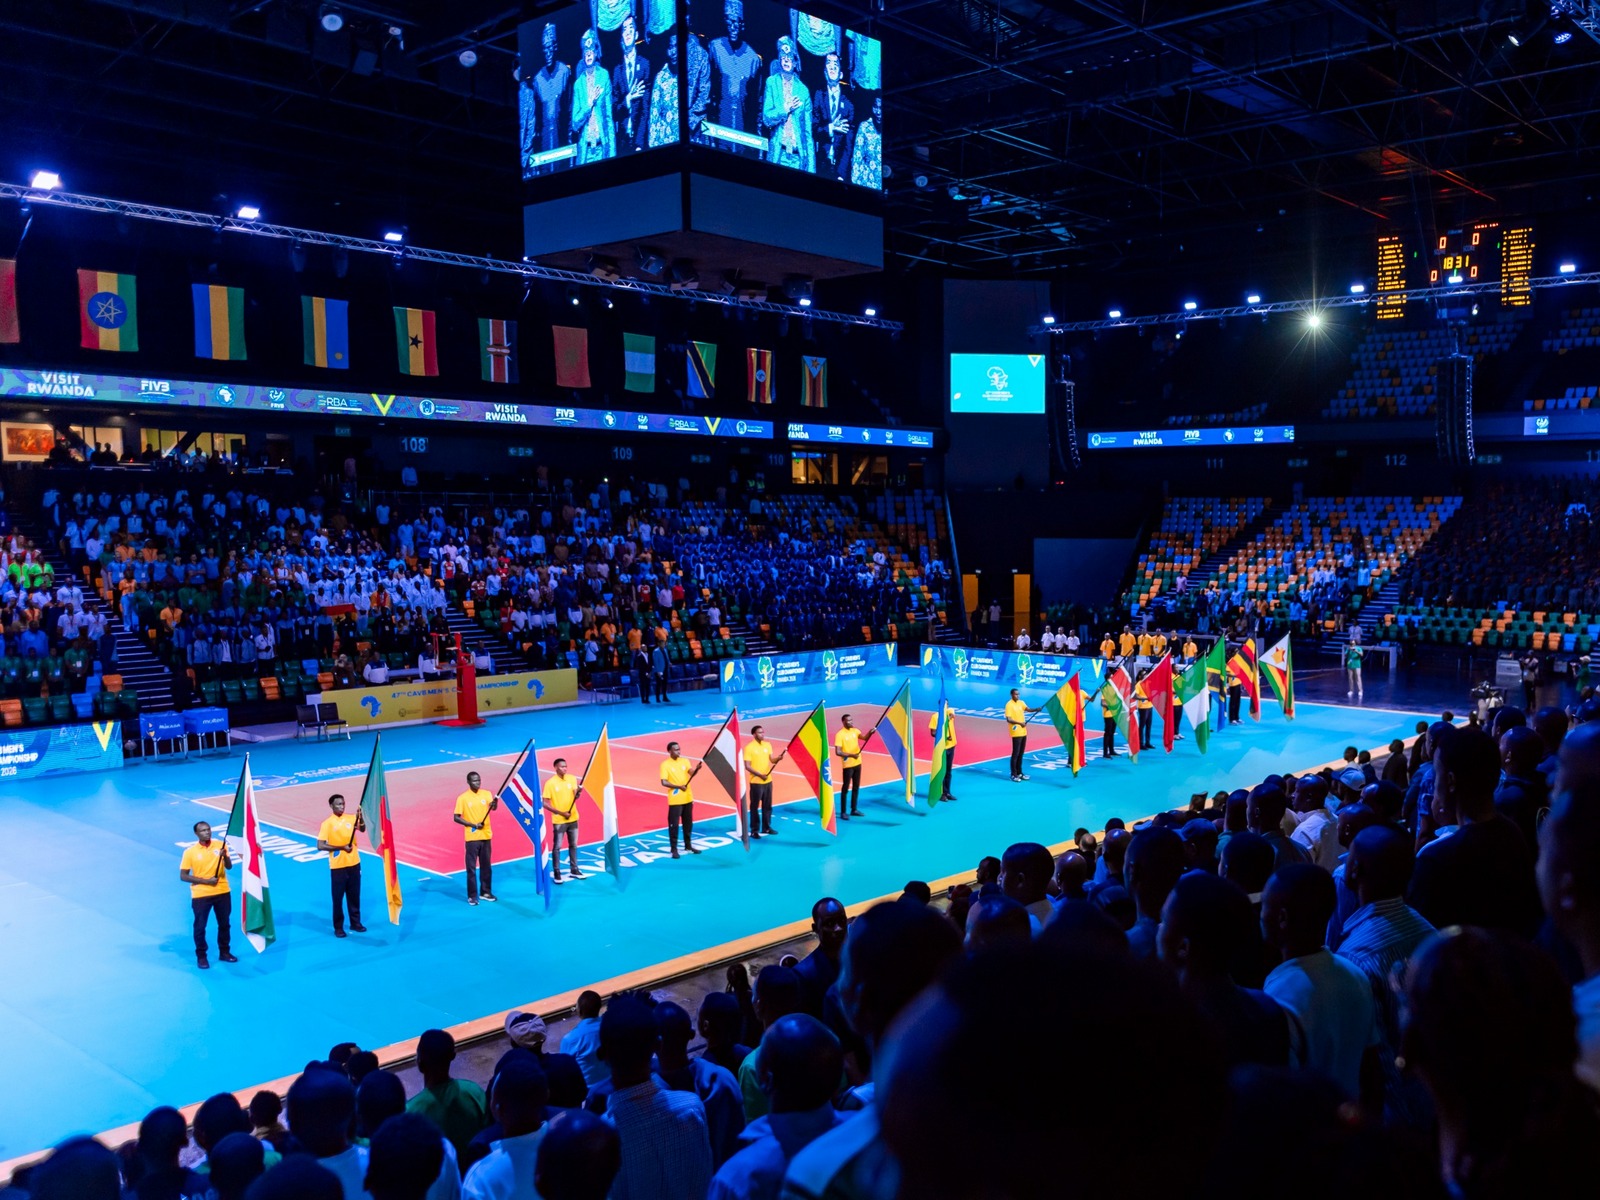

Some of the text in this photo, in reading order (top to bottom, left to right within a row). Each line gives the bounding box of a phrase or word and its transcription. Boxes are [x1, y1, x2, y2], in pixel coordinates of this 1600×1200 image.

[1440, 237, 1446, 249] 0
[1472, 233, 1479, 245] 0
[1431, 270, 1437, 281] 0
[1471, 266, 1477, 277] 0
[41, 373, 80, 385] VISIT
[27, 382, 95, 397] RWANDA
[140, 380, 170, 392] FIVB
[493, 404, 519, 414] VISIT
[555, 409, 575, 418] FIVB
[485, 412, 528, 423] RWANDA
[1139, 431, 1157, 439] VISIT
[1184, 430, 1200, 438] FIVB
[401, 437, 427, 452] 108
[1132, 437, 1163, 446] RWANDA
[613, 447, 633, 460] 109
[768, 454, 784, 466] 110
[1206, 458, 1223, 469] 111
[1384, 454, 1407, 466] 112
[477, 680, 519, 689] HAMPIONSHIP
